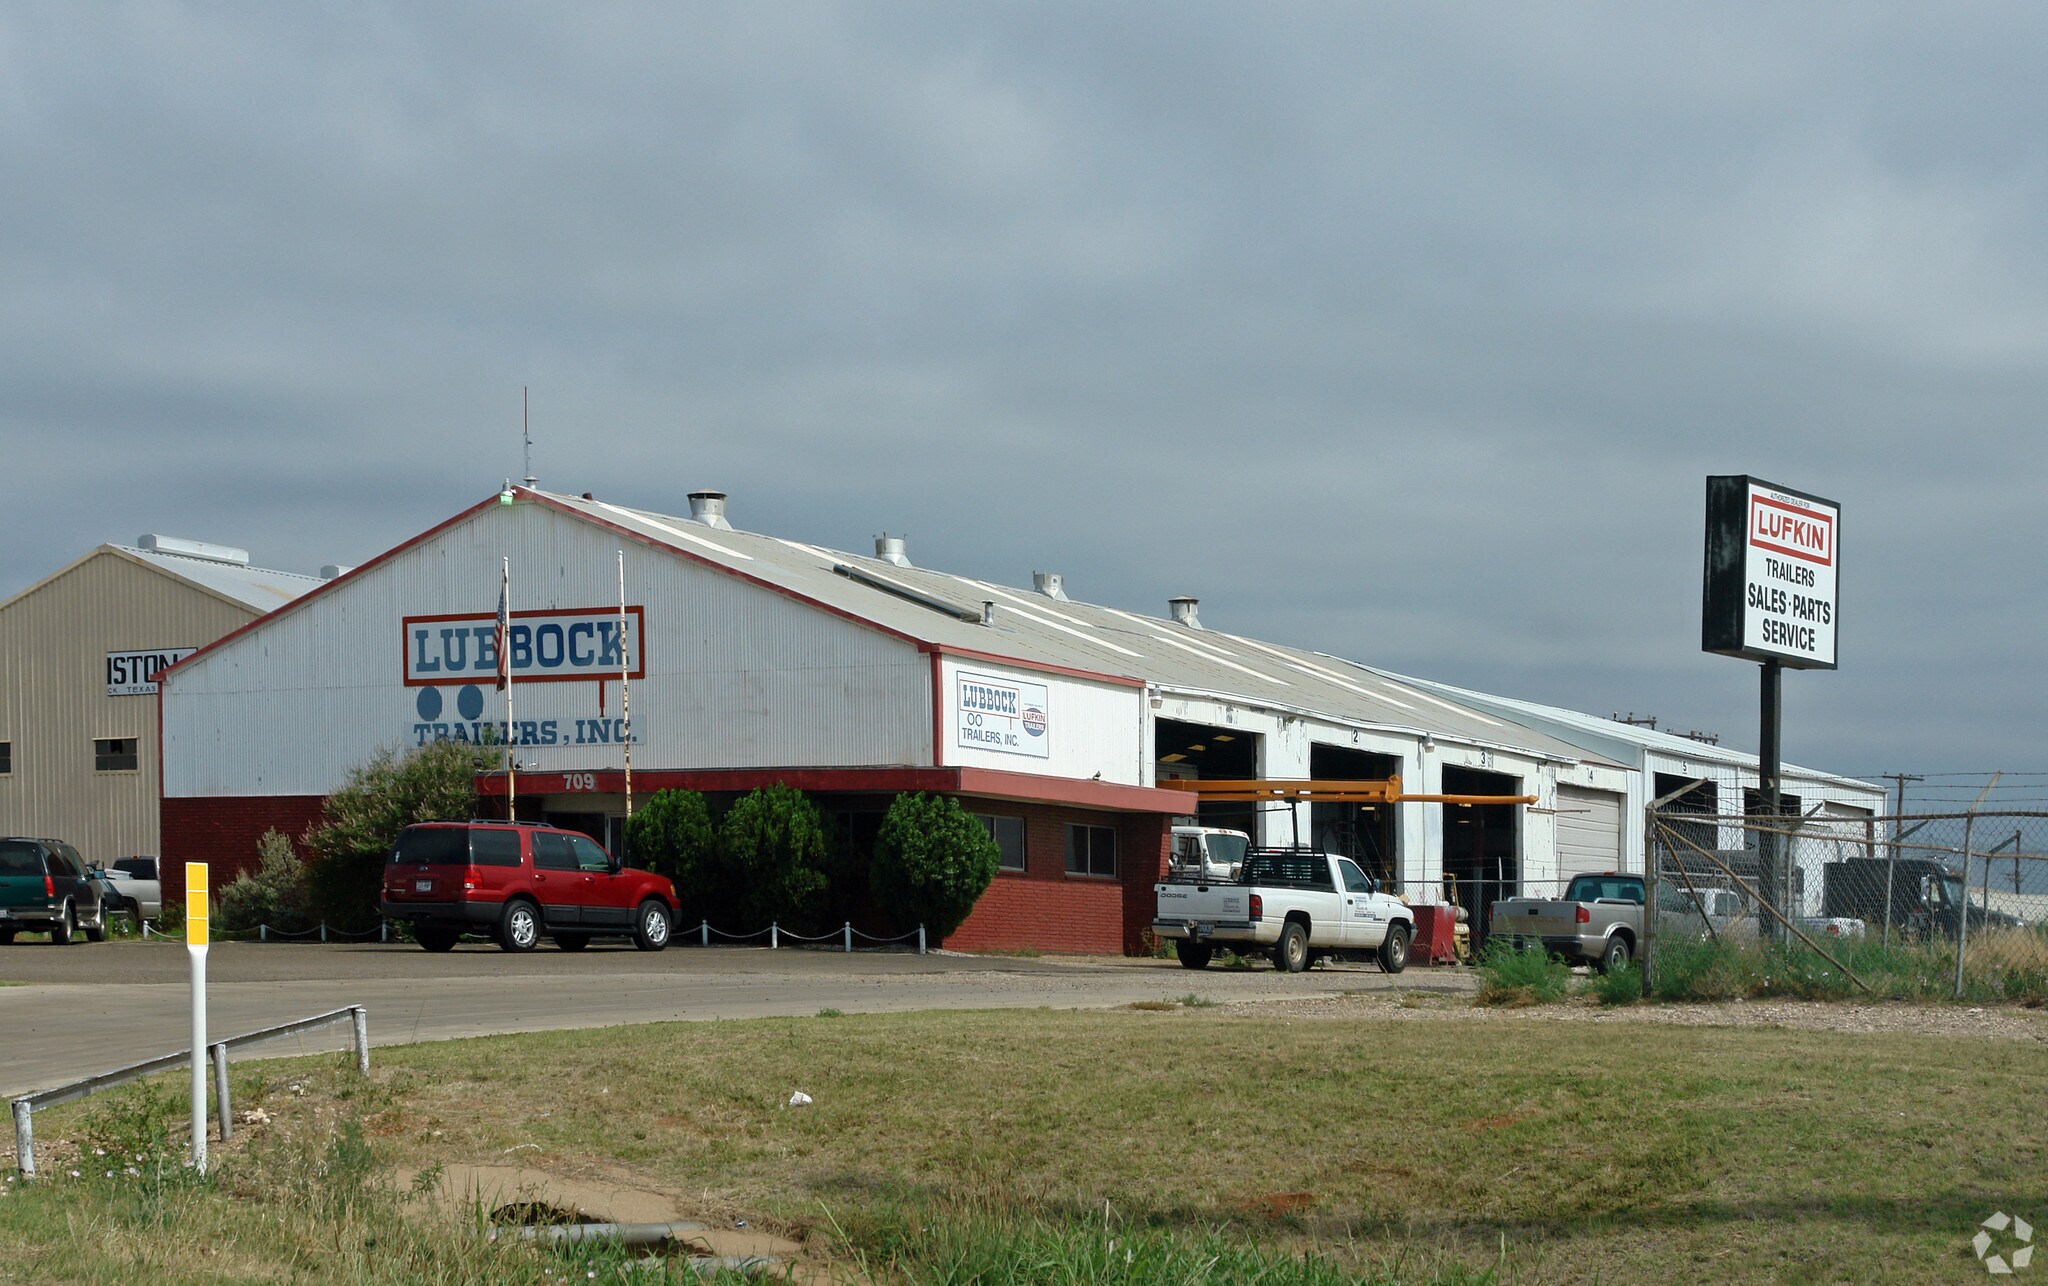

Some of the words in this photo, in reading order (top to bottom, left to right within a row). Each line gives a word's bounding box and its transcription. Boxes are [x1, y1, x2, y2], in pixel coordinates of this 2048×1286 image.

[1758, 510, 1825, 551] LUFKIN
[1765, 557, 1815, 588] TRAILERS
[1748, 582, 1787, 615] SALES
[1793, 594, 1831, 625] PARTS
[1762, 618, 1815, 652] SERVICE
[415, 621, 630, 672] LUBBOCK
[127, 685, 156, 693] TEXAS
[963, 684, 1016, 714] LUBBOCK
[1022, 711, 1046, 723] LUFKIN
[575, 719, 638, 744] INC.
[962, 727, 1003, 746] TRAILERS,
[1004, 733, 1020, 747] INC.
[1353, 729, 1358, 743] 2
[1480, 752, 1486, 765] 3
[1682, 760, 1687, 772] 5
[562, 773, 596, 790] 709
